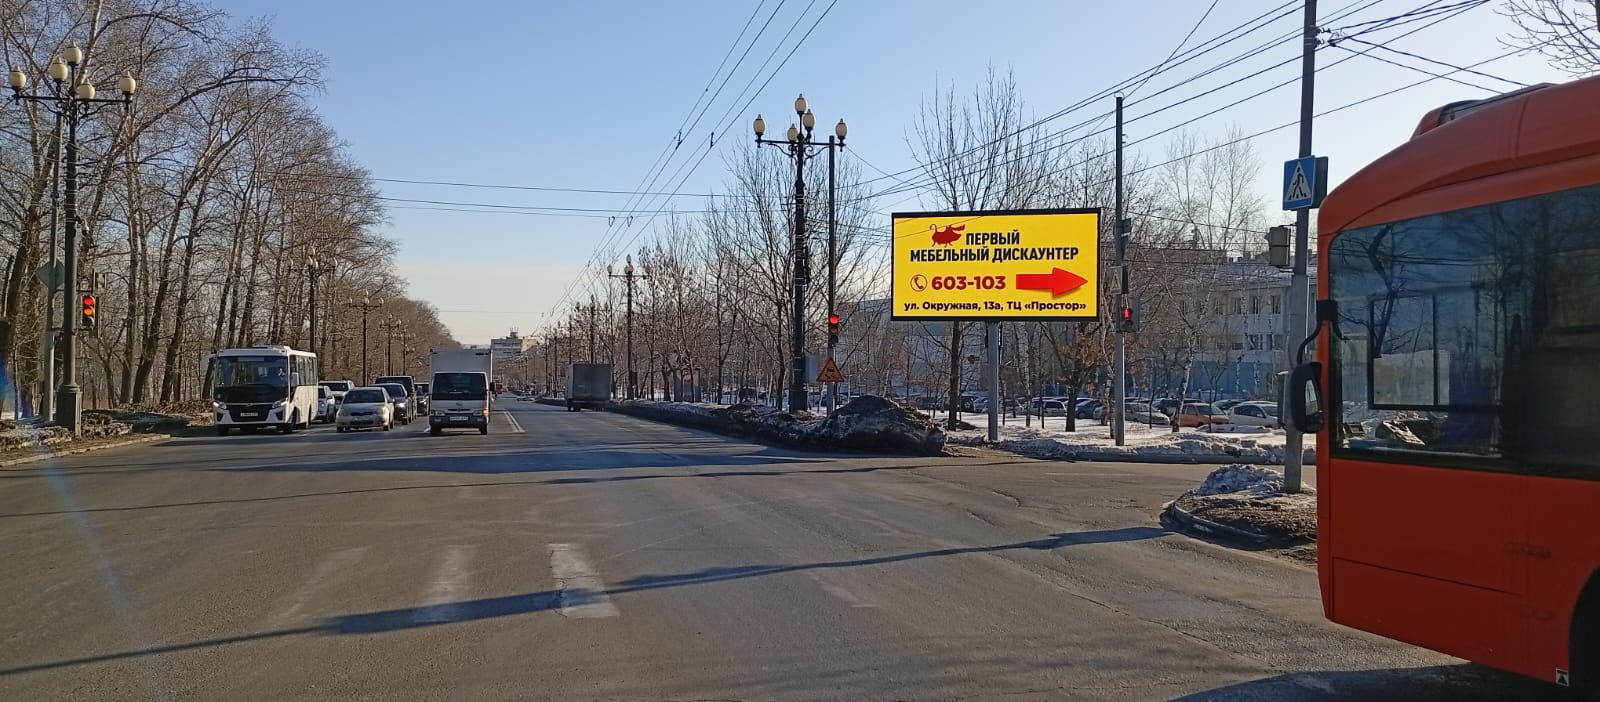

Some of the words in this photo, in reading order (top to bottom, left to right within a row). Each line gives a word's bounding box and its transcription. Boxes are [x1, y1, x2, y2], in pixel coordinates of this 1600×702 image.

[966, 230, 1020, 245] ПЕРВЫЙ
[911, 247, 989, 262] МЕБЕЛЬНЫЙ
[992, 247, 1078, 263] ДИСКАУНТЕР
[932, 276, 1006, 290] 603-103
[904, 302, 919, 311] ул.
[923, 301, 981, 311] Окружная,
[984, 301, 1003, 311] 13а,
[1007, 302, 1021, 311] ТЦ
[1025, 302, 1086, 311] «Простор»
